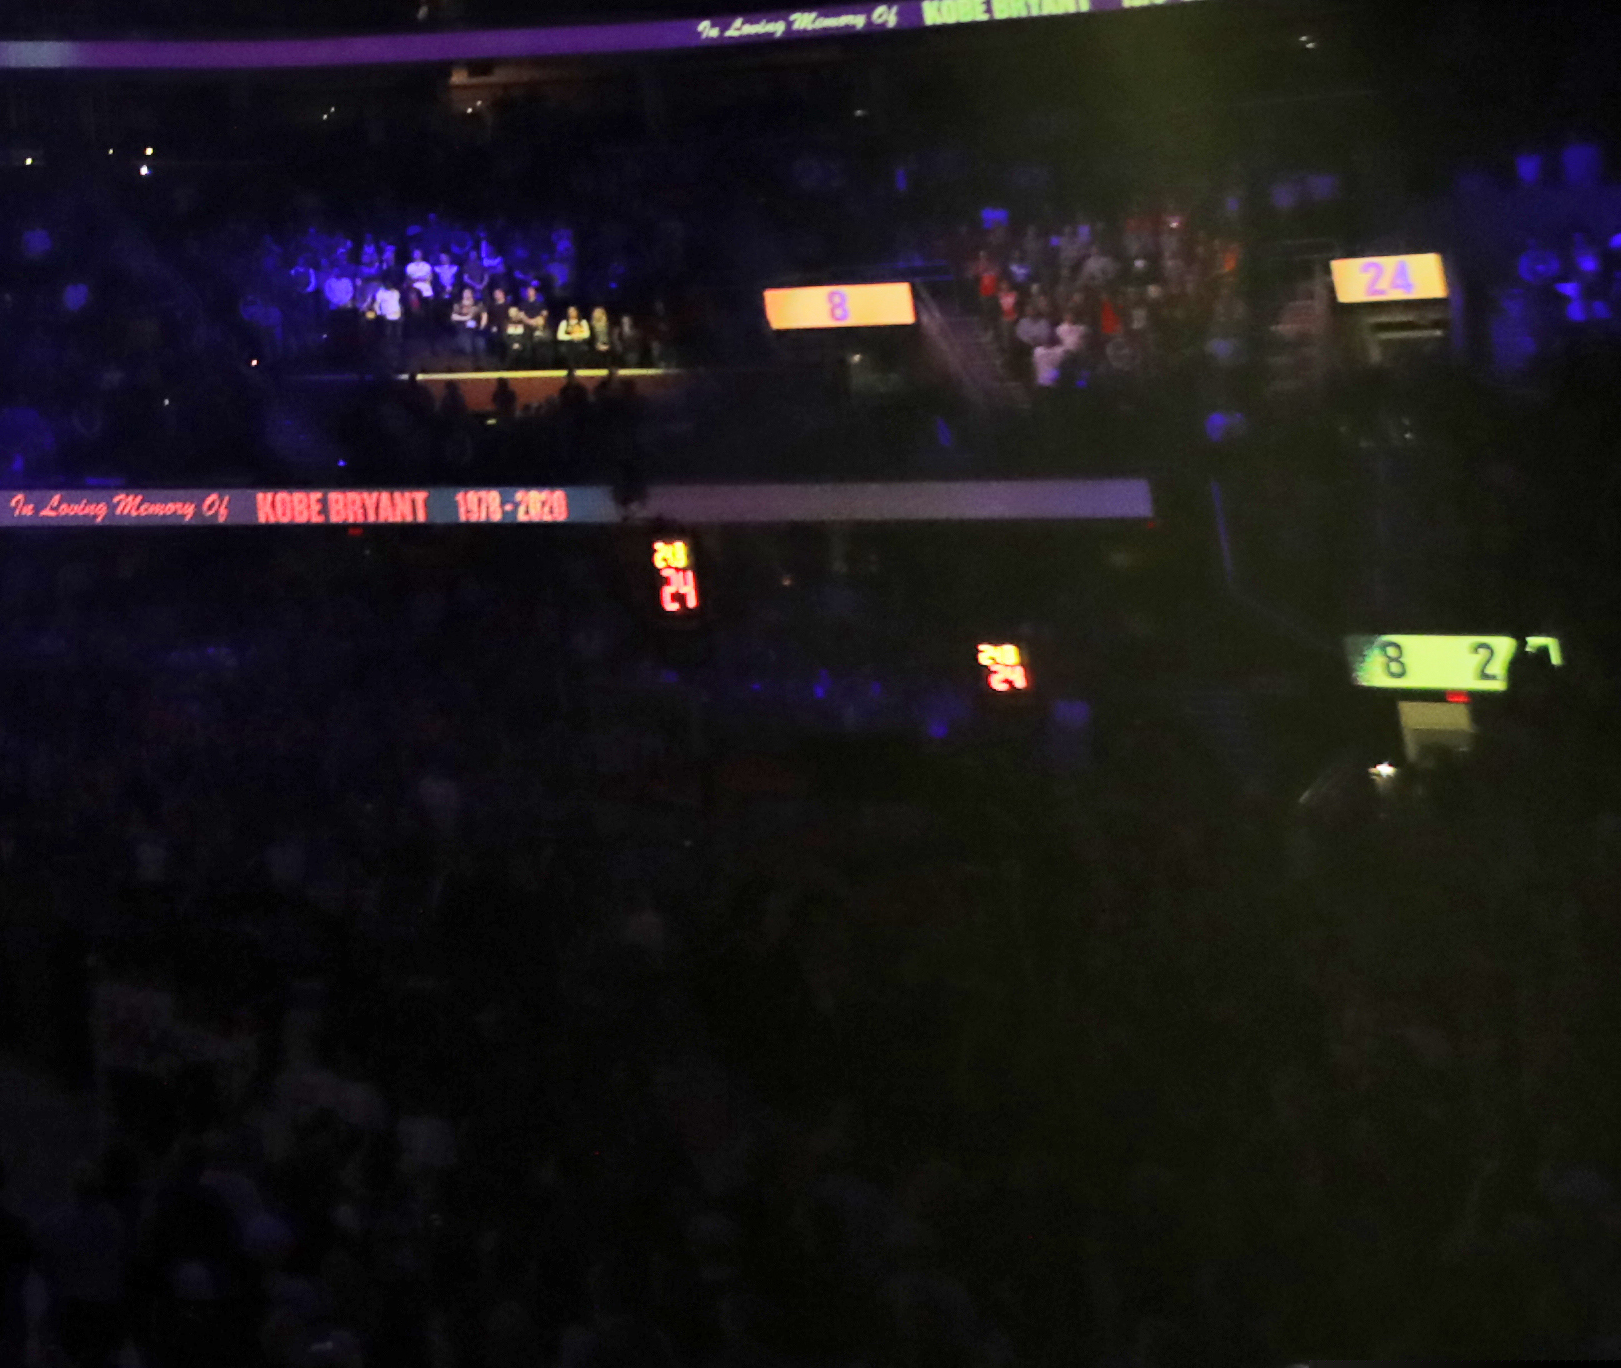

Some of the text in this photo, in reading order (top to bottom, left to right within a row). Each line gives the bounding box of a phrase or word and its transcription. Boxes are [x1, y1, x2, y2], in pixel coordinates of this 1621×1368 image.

[697, 20, 719, 39] In
[872, 5, 898, 28] Of
[1359, 261, 1414, 296] 24
[826, 289, 848, 321] 8
[10, 493, 34, 515] In
[39, 493, 108, 521] Loving
[113, 493, 197, 521] Memory
[201, 493, 229, 521] Of
[257, 491, 325, 523] KOBE
[327, 491, 429, 523] BRYANT
[455, 491, 501, 521] 1978
[516, 490, 568, 521] 2020
[660, 568, 698, 611] 24
[987, 664, 1027, 691] 24
[1381, 641, 1502, 681] 8 2
